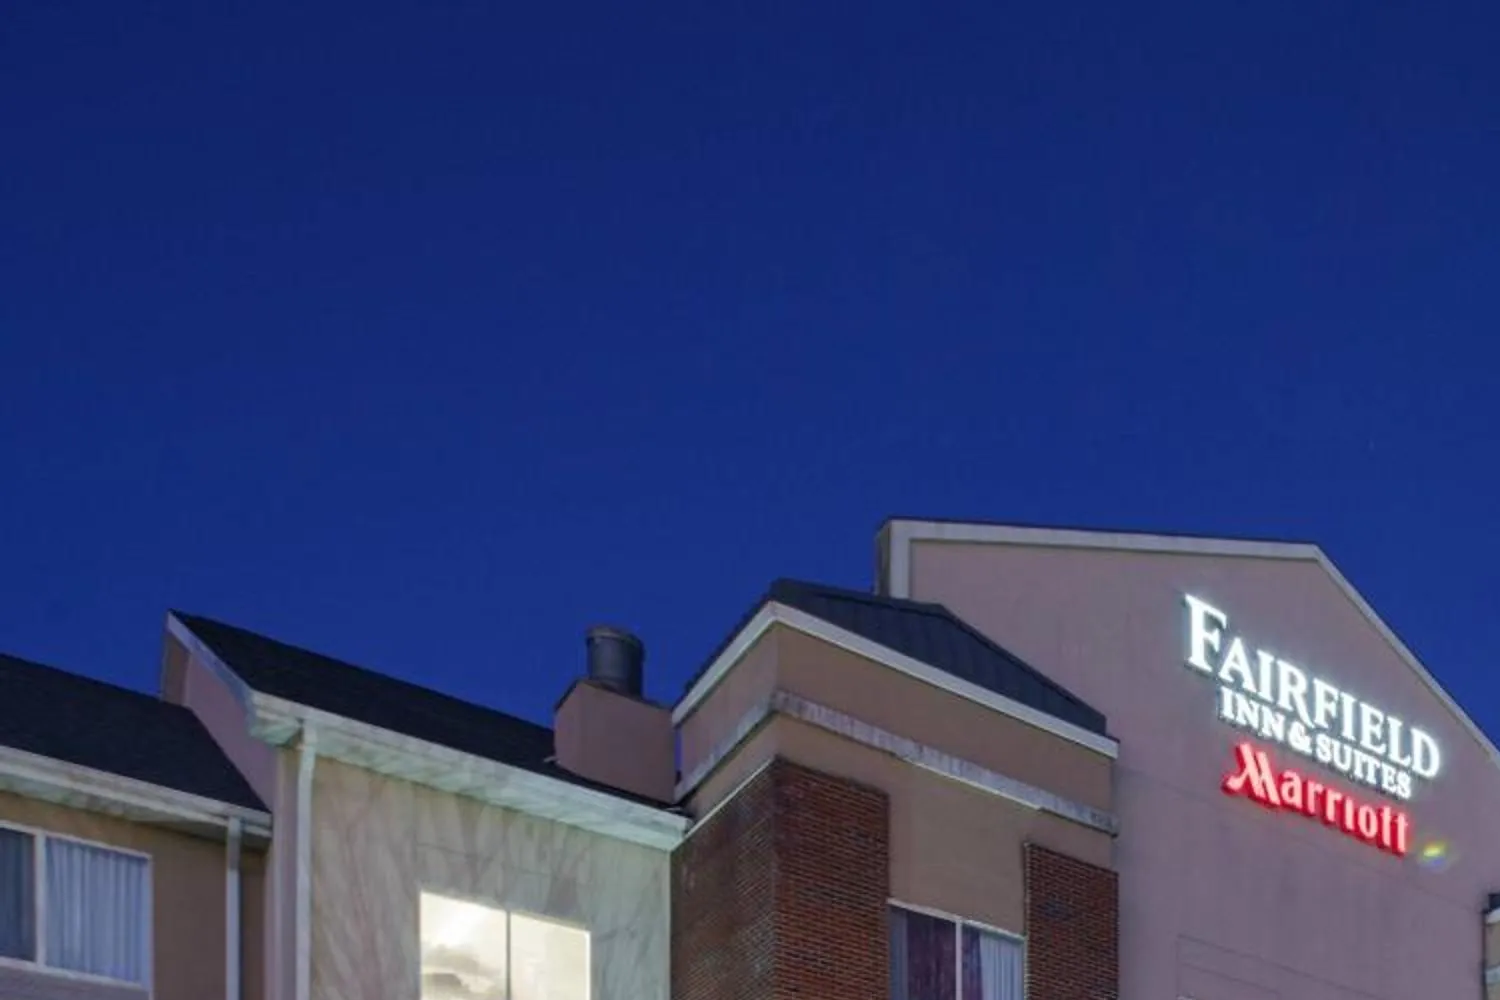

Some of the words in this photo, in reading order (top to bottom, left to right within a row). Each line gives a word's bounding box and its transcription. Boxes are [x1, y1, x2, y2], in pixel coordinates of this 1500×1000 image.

[1184, 592, 1441, 779] FAIRFIELD
[1220, 686, 1285, 742] INN
[1287, 721, 1313, 754] &
[1315, 733, 1412, 800] SUITES
[1223, 743, 1409, 857] Marriott
